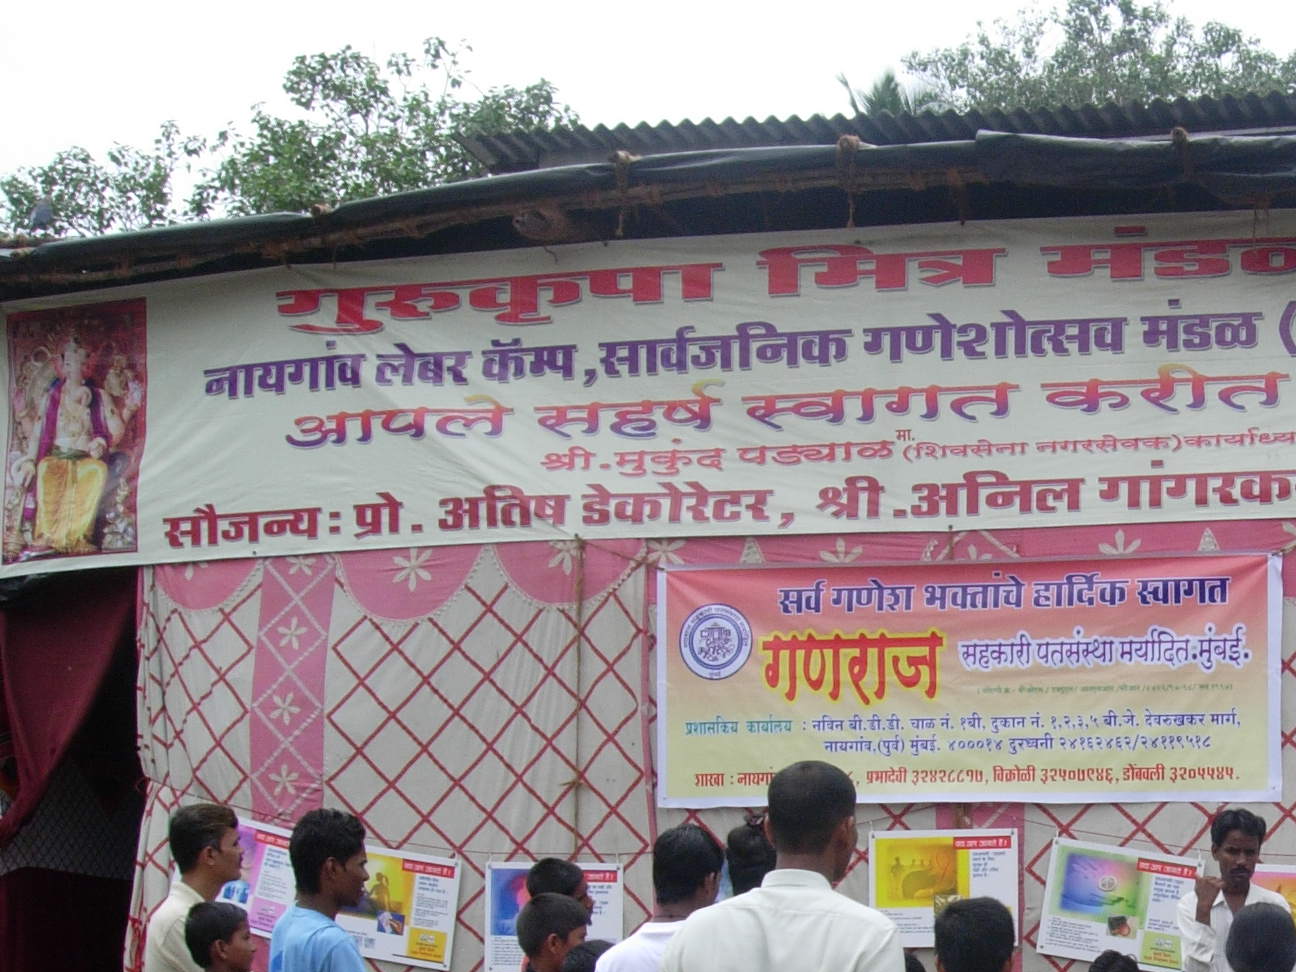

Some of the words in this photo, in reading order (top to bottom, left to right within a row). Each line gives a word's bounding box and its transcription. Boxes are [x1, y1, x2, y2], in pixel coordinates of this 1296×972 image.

[276, 261, 726, 334] गुरुकृपा
[757, 243, 1008, 292] मित्र
[204, 339, 367, 400] नायगांव
[375, 342, 471, 388] लेबर
[600, 320, 852, 377] सार्वजनिक
[863, 310, 1129, 363] गणेशोत्सव
[1140, 299, 1264, 352] मंडळ
[286, 395, 514, 448] आपले
[536, 379, 725, 442] सहर्ष
[742, 383, 1020, 431] स्वागत
[1042, 364, 1289, 415] करीत
[437, 483, 569, 531] अतिष
[779, 580, 825, 614] सर्व
[832, 579, 914, 613] गणेश
[924, 572, 1024, 611] भक्तांचे
[1032, 574, 1128, 608] हार्दिक
[1137, 577, 1230, 606] स्वागत
[762, 631, 944, 706] गणराज
[961, 634, 1031, 668] सहकारी
[1037, 630, 1113, 666] पतसंस्था
